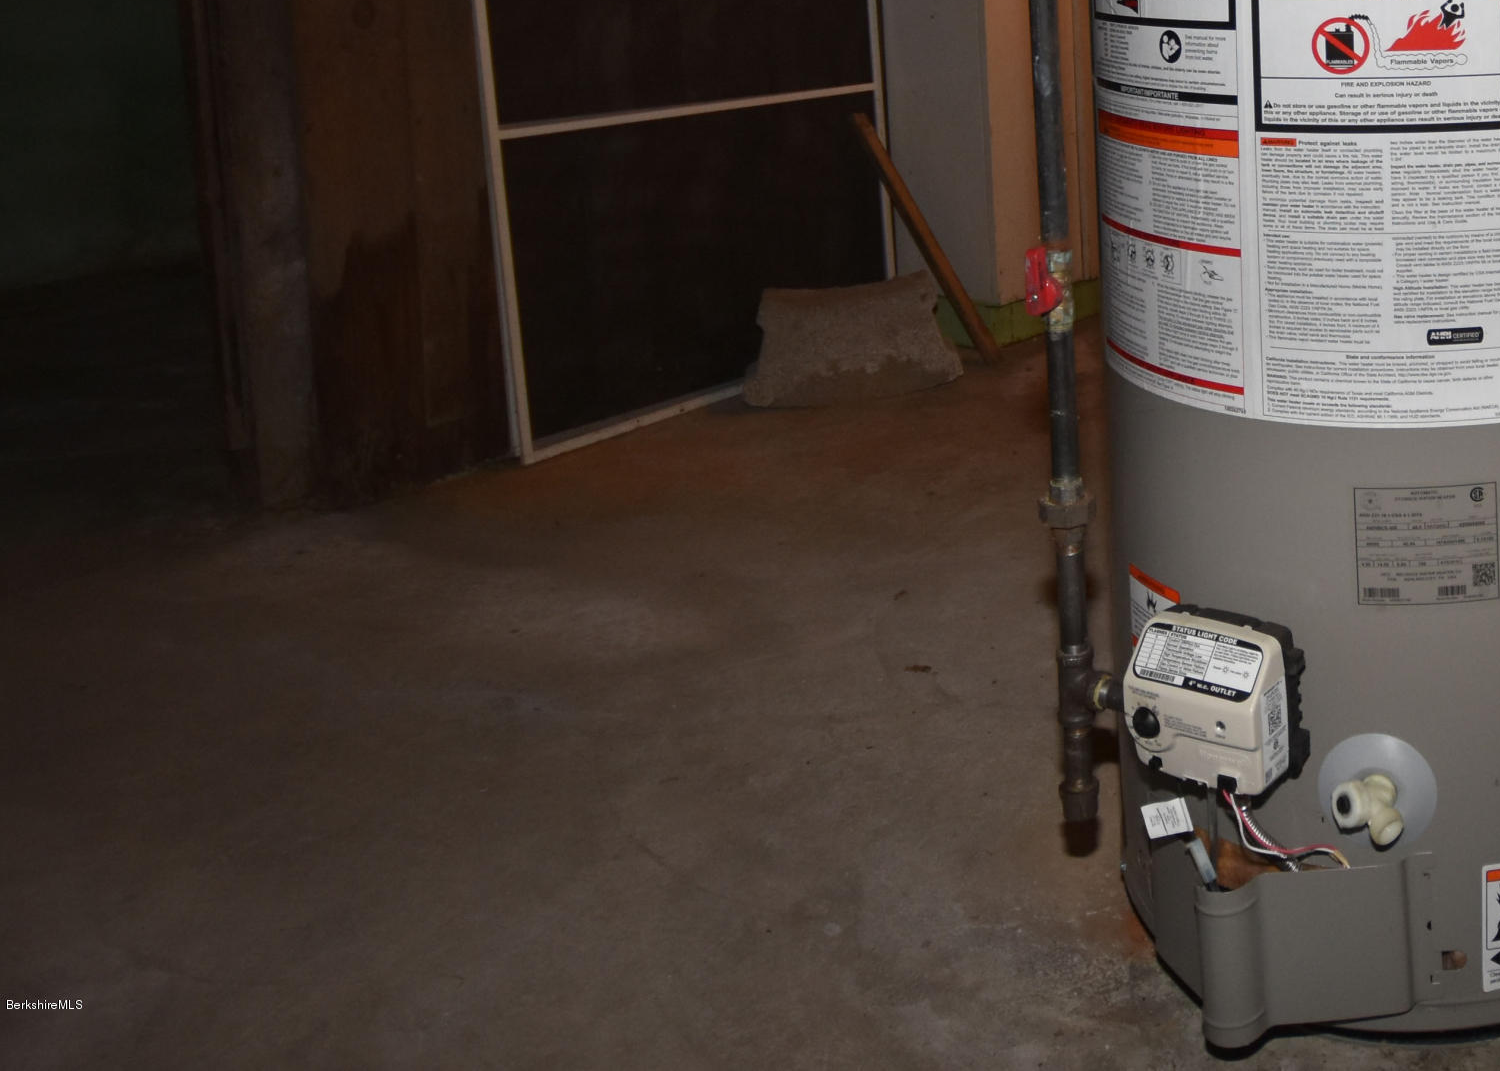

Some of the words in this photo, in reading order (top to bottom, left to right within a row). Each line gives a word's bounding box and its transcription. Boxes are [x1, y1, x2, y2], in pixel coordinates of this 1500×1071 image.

[1390, 58, 1427, 66] Flammable
[1430, 58, 1454, 66] Vapors
[1172, 625, 1197, 636] STATUS
[1197, 631, 1218, 641] LIGHT
[1218, 634, 1238, 645] CODE
[1210, 686, 1236, 697] OUTLET
